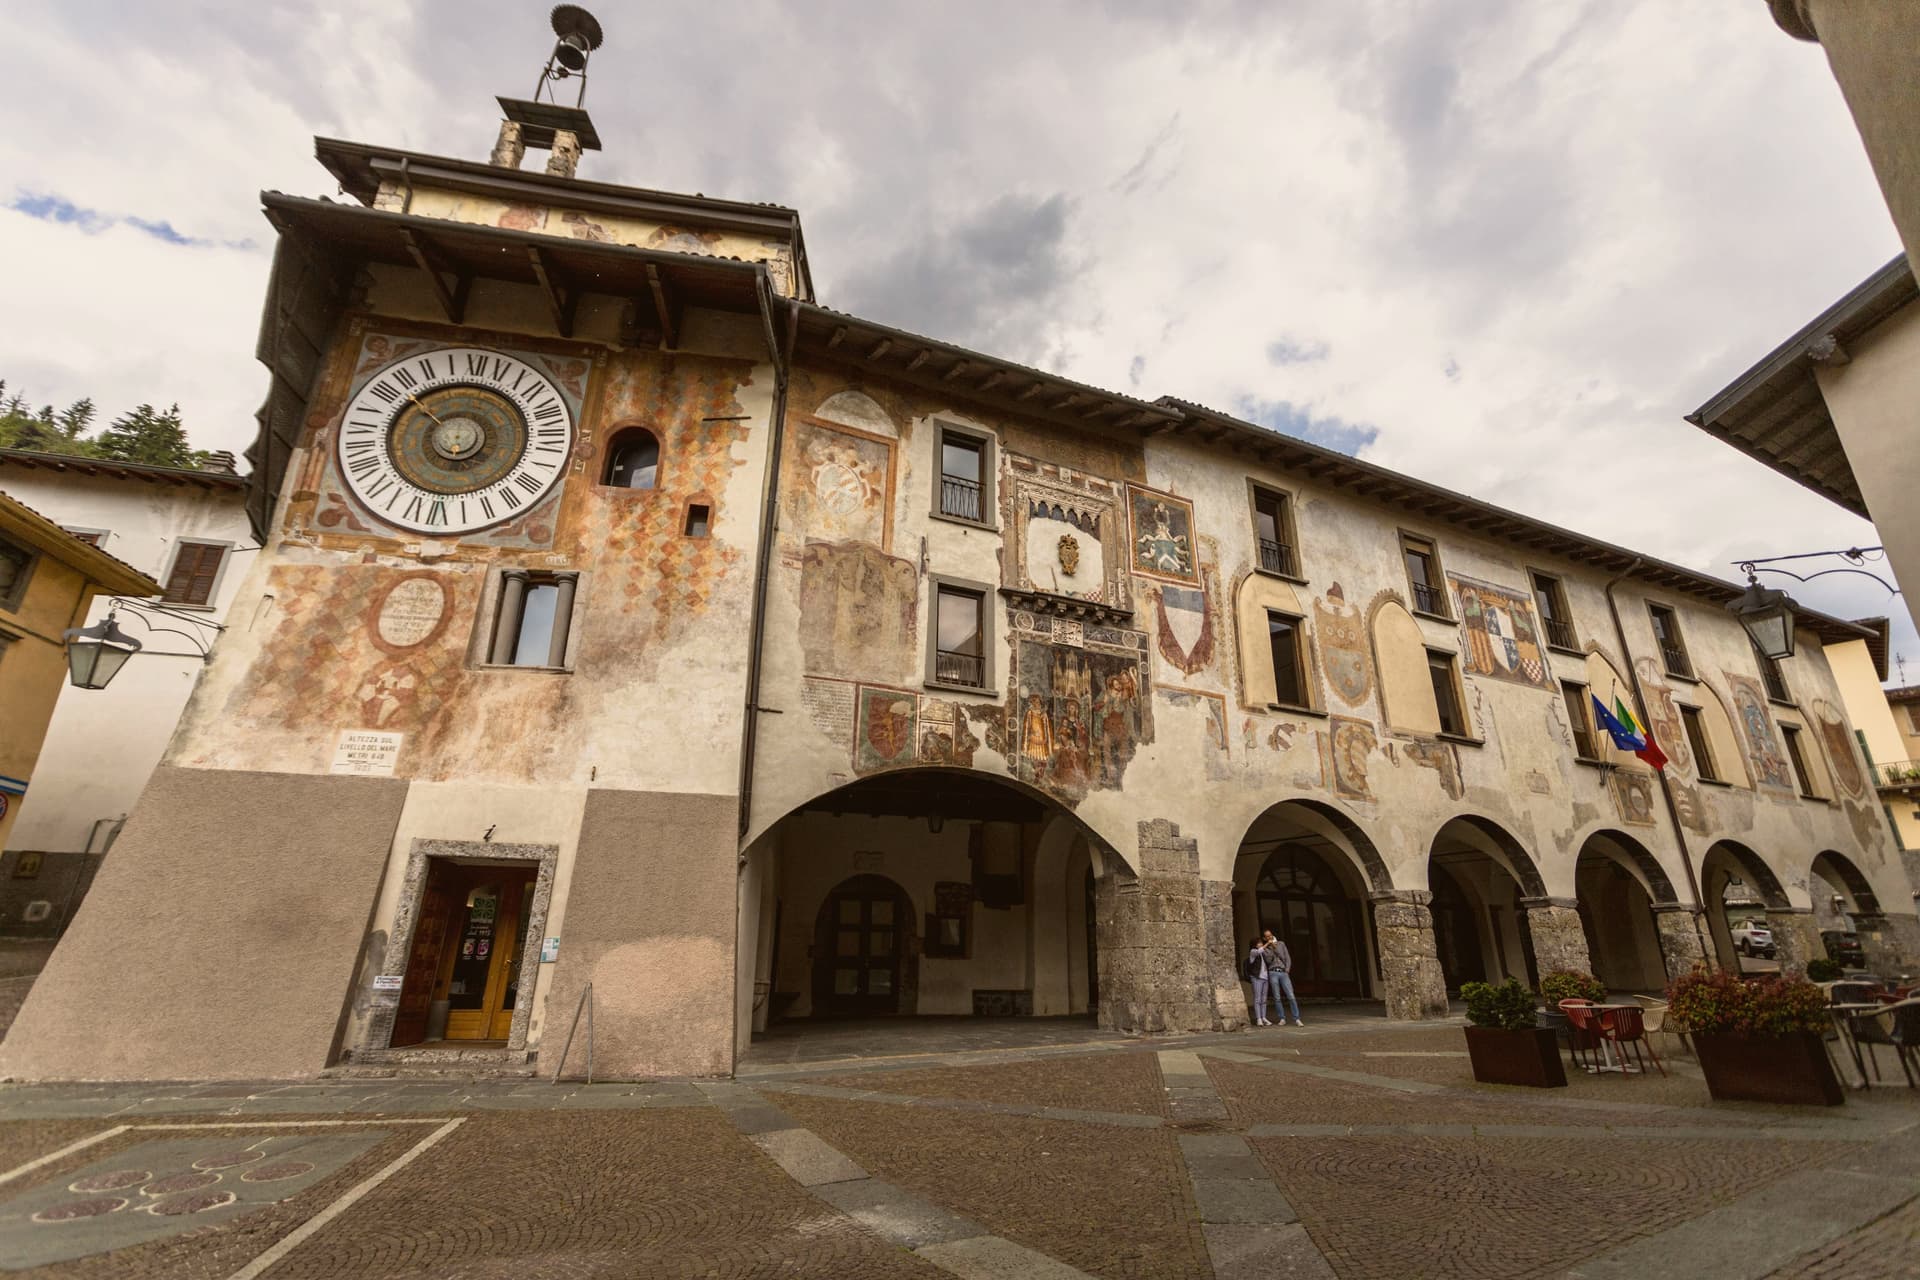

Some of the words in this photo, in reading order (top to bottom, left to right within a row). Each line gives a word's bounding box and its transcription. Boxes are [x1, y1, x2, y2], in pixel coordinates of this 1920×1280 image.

[419, 359, 436, 381] II
[448, 354, 455, 375] I
[465, 354, 489, 377] XII
[487, 358, 512, 382] XI
[392, 367, 418, 390] III
[508, 369, 532, 391] X
[370, 380, 402, 404] IIII
[520, 380, 550, 403] IX
[356, 400, 384, 414] V
[533, 397, 562, 420] VIII
[347, 421, 378, 434] VI
[536, 418, 565, 437] VII
[346, 440, 376, 458] VII
[536, 440, 565, 453] VI
[348, 455, 381, 482] VIII
[530, 460, 556, 475] V
[360, 473, 394, 499] IX
[514, 471, 544, 495] IIII
[378, 487, 408, 511] X
[402, 495, 427, 523] XI
[479, 496, 496, 520] II
[498, 486, 522, 510] III
[425, 501, 450, 526] XII
[461, 501, 466, 525] I
[340, 743, 366, 751] LIVELLO
[367, 744, 377, 752] DEL
[380, 745, 397, 753] MARE
[348, 735, 378, 743] ALTEZZA
